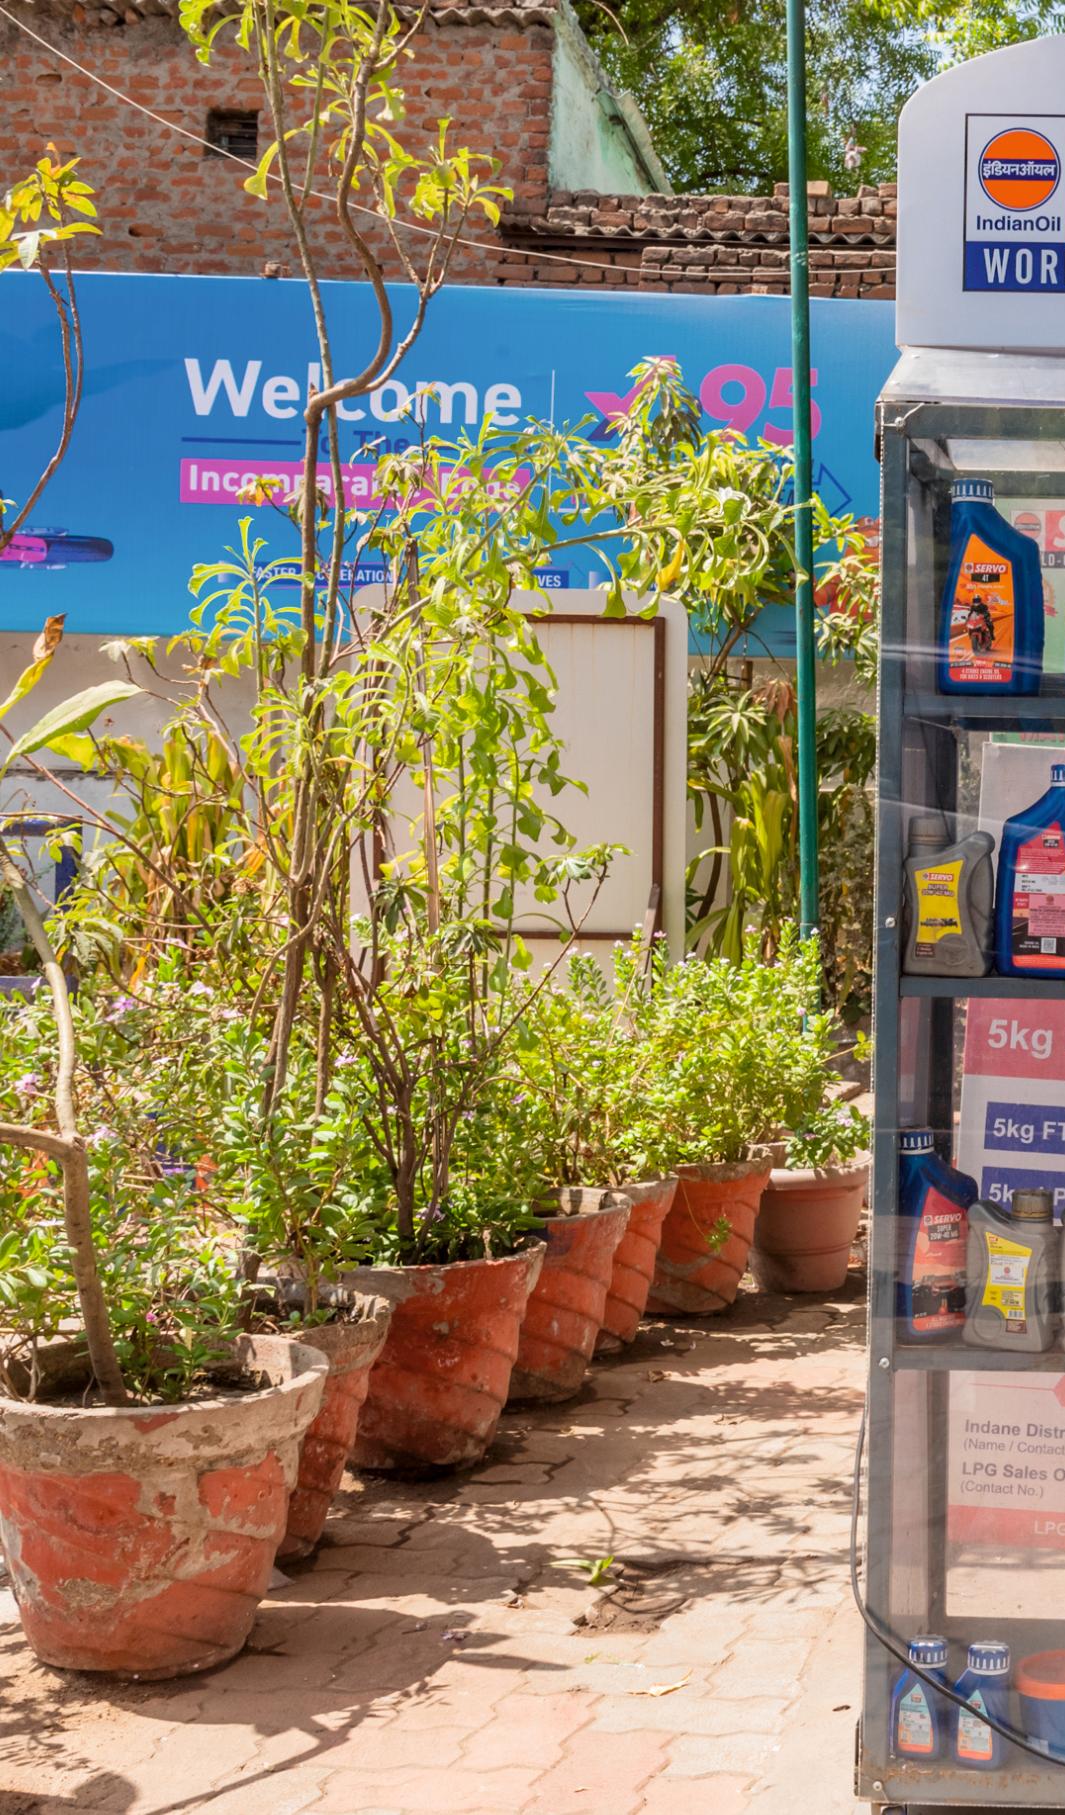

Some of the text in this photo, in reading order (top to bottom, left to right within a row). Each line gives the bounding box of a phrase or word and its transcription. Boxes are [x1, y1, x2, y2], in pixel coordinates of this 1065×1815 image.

[983, 161, 1056, 179] इंडियनऑयल
[976, 215, 1061, 231] IndianOil
[184, 358, 522, 427] Welcome
[354, 430, 410, 455] The
[975, 563, 1006, 573] SERVO
[930, 873, 953, 881] SERVO
[988, 1019, 1052, 1060] 5kg
[993, 1118, 1034, 1144] 5kg
[988, 1183, 1014, 1204] 5k
[934, 1213, 961, 1224] SERVO
[964, 1419, 1020, 1437] Indane
[963, 1437, 1006, 1452] (Name
[1017, 1441, 1065, 1457] Contact
[962, 1462, 997, 1477] LPG
[1003, 1463, 1048, 1481] Sales
[960, 1480, 1044, 1498] (Contact No.)
